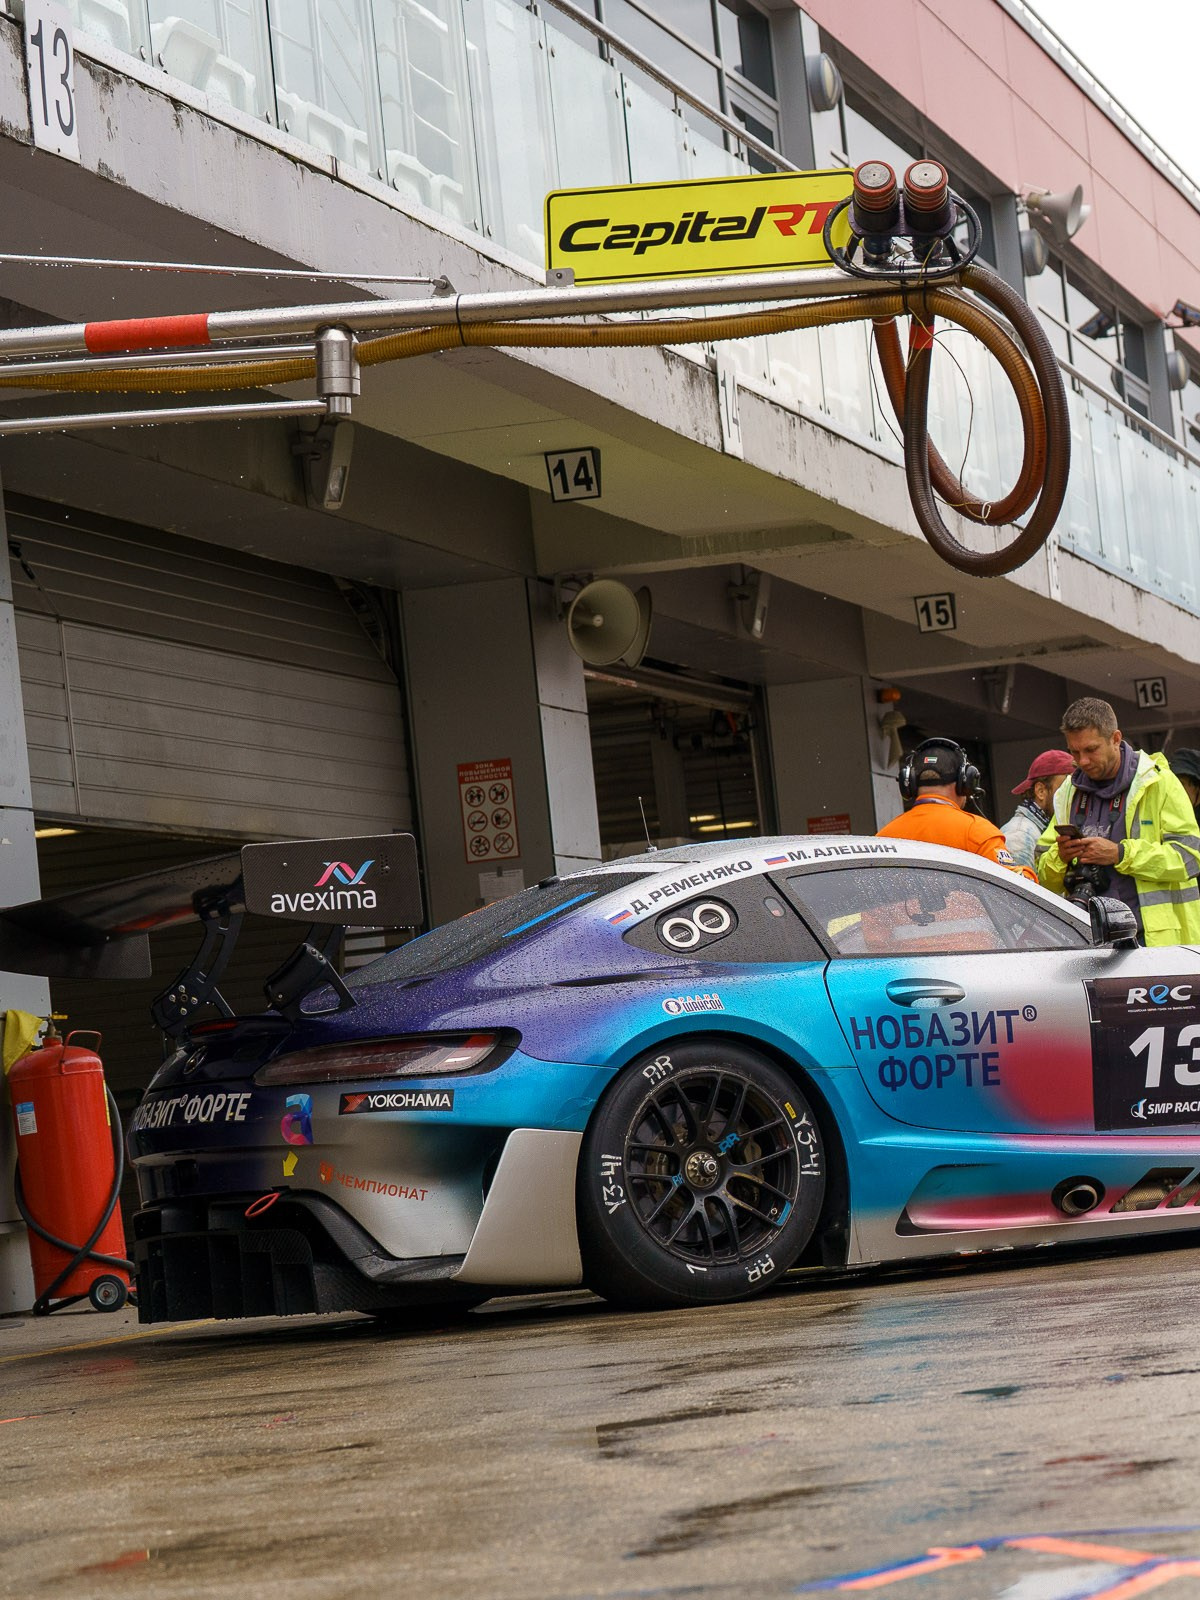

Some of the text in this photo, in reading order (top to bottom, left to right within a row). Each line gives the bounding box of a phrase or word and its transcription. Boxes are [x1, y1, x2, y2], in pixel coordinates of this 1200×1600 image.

[30, 19, 75, 137] 13
[552, 456, 594, 495] 14
[919, 599, 951, 628] 15
[1138, 681, 1164, 706] 16
[270, 885, 378, 914] avexima
[877, 1051, 1001, 1093] ФОРТЕ
[183, 1092, 252, 1124] ФОРТЕ
[367, 1093, 451, 1110] YOKOHAMA
[1147, 1103, 1173, 1115] SMP
[336, 1172, 429, 1202] ЧЕМПИОНАТ
